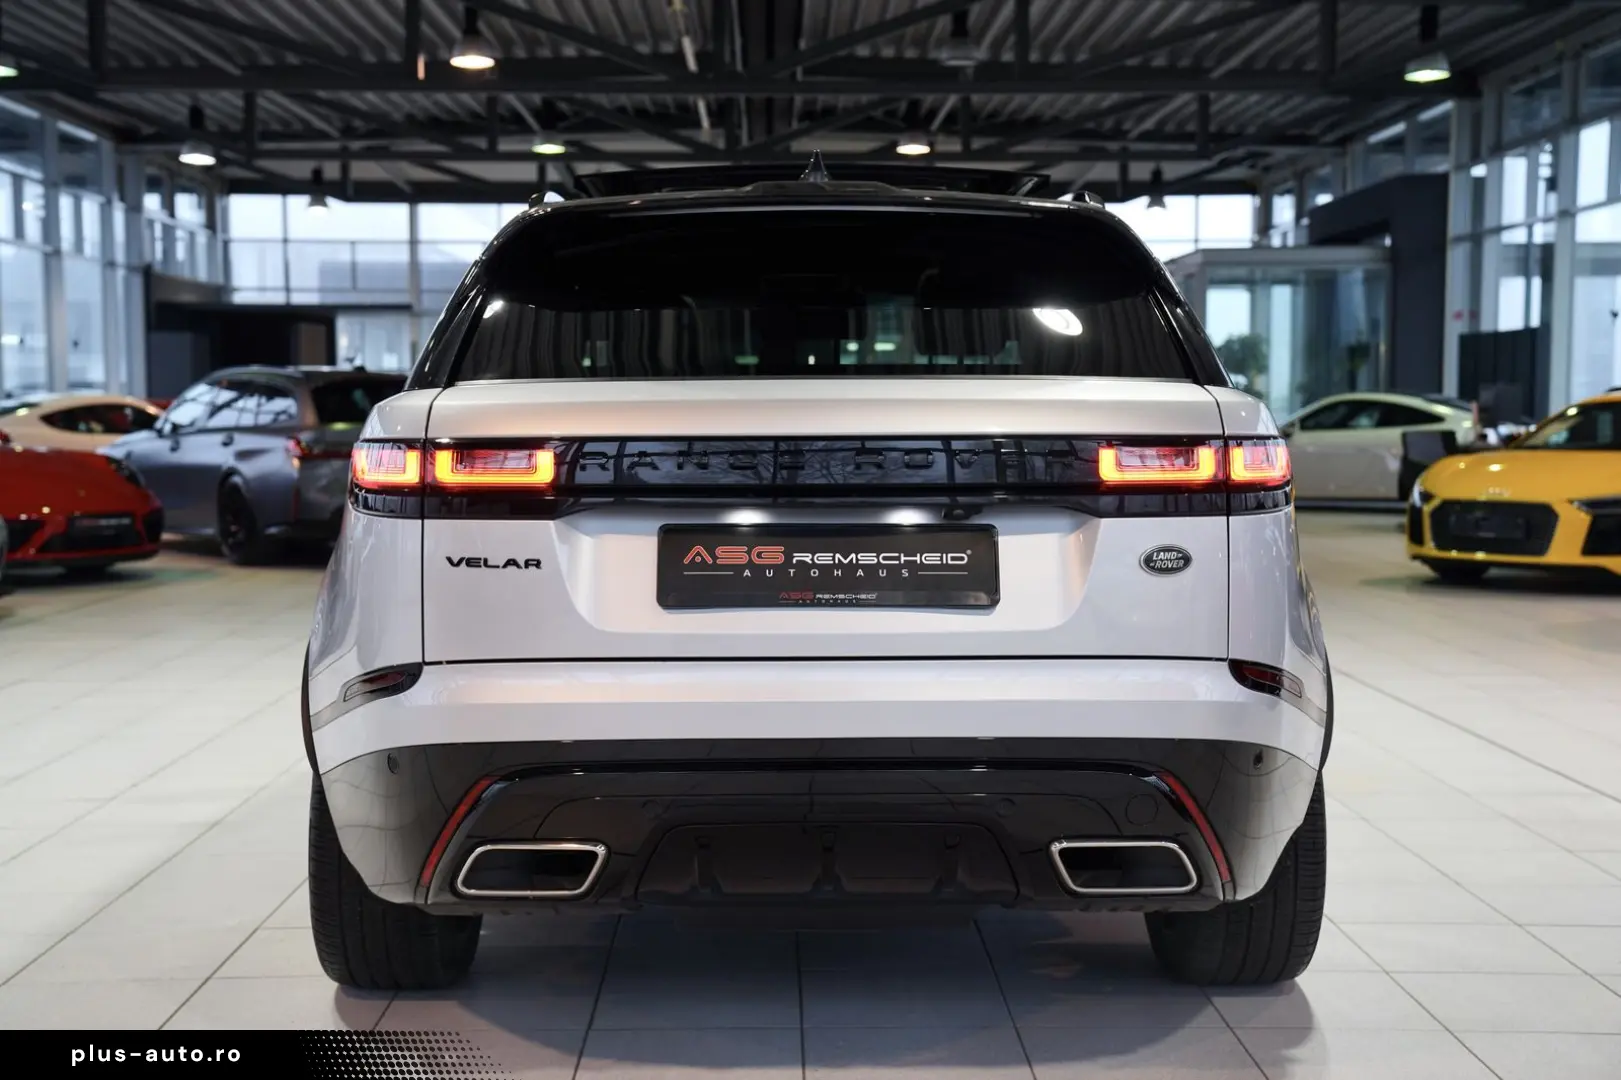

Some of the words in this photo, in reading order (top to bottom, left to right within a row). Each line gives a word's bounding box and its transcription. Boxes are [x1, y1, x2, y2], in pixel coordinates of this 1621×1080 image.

[578, 450, 806, 472] RANGE
[854, 449, 1077, 471] ROVER
[683, 545, 785, 565] ASG
[1152, 551, 1177, 560] LAND
[445, 556, 542, 570] VELAR
[1154, 560, 1184, 568] ROVER
[743, 569, 909, 577] AUTOHAUS
[779, 592, 815, 600] ASG
